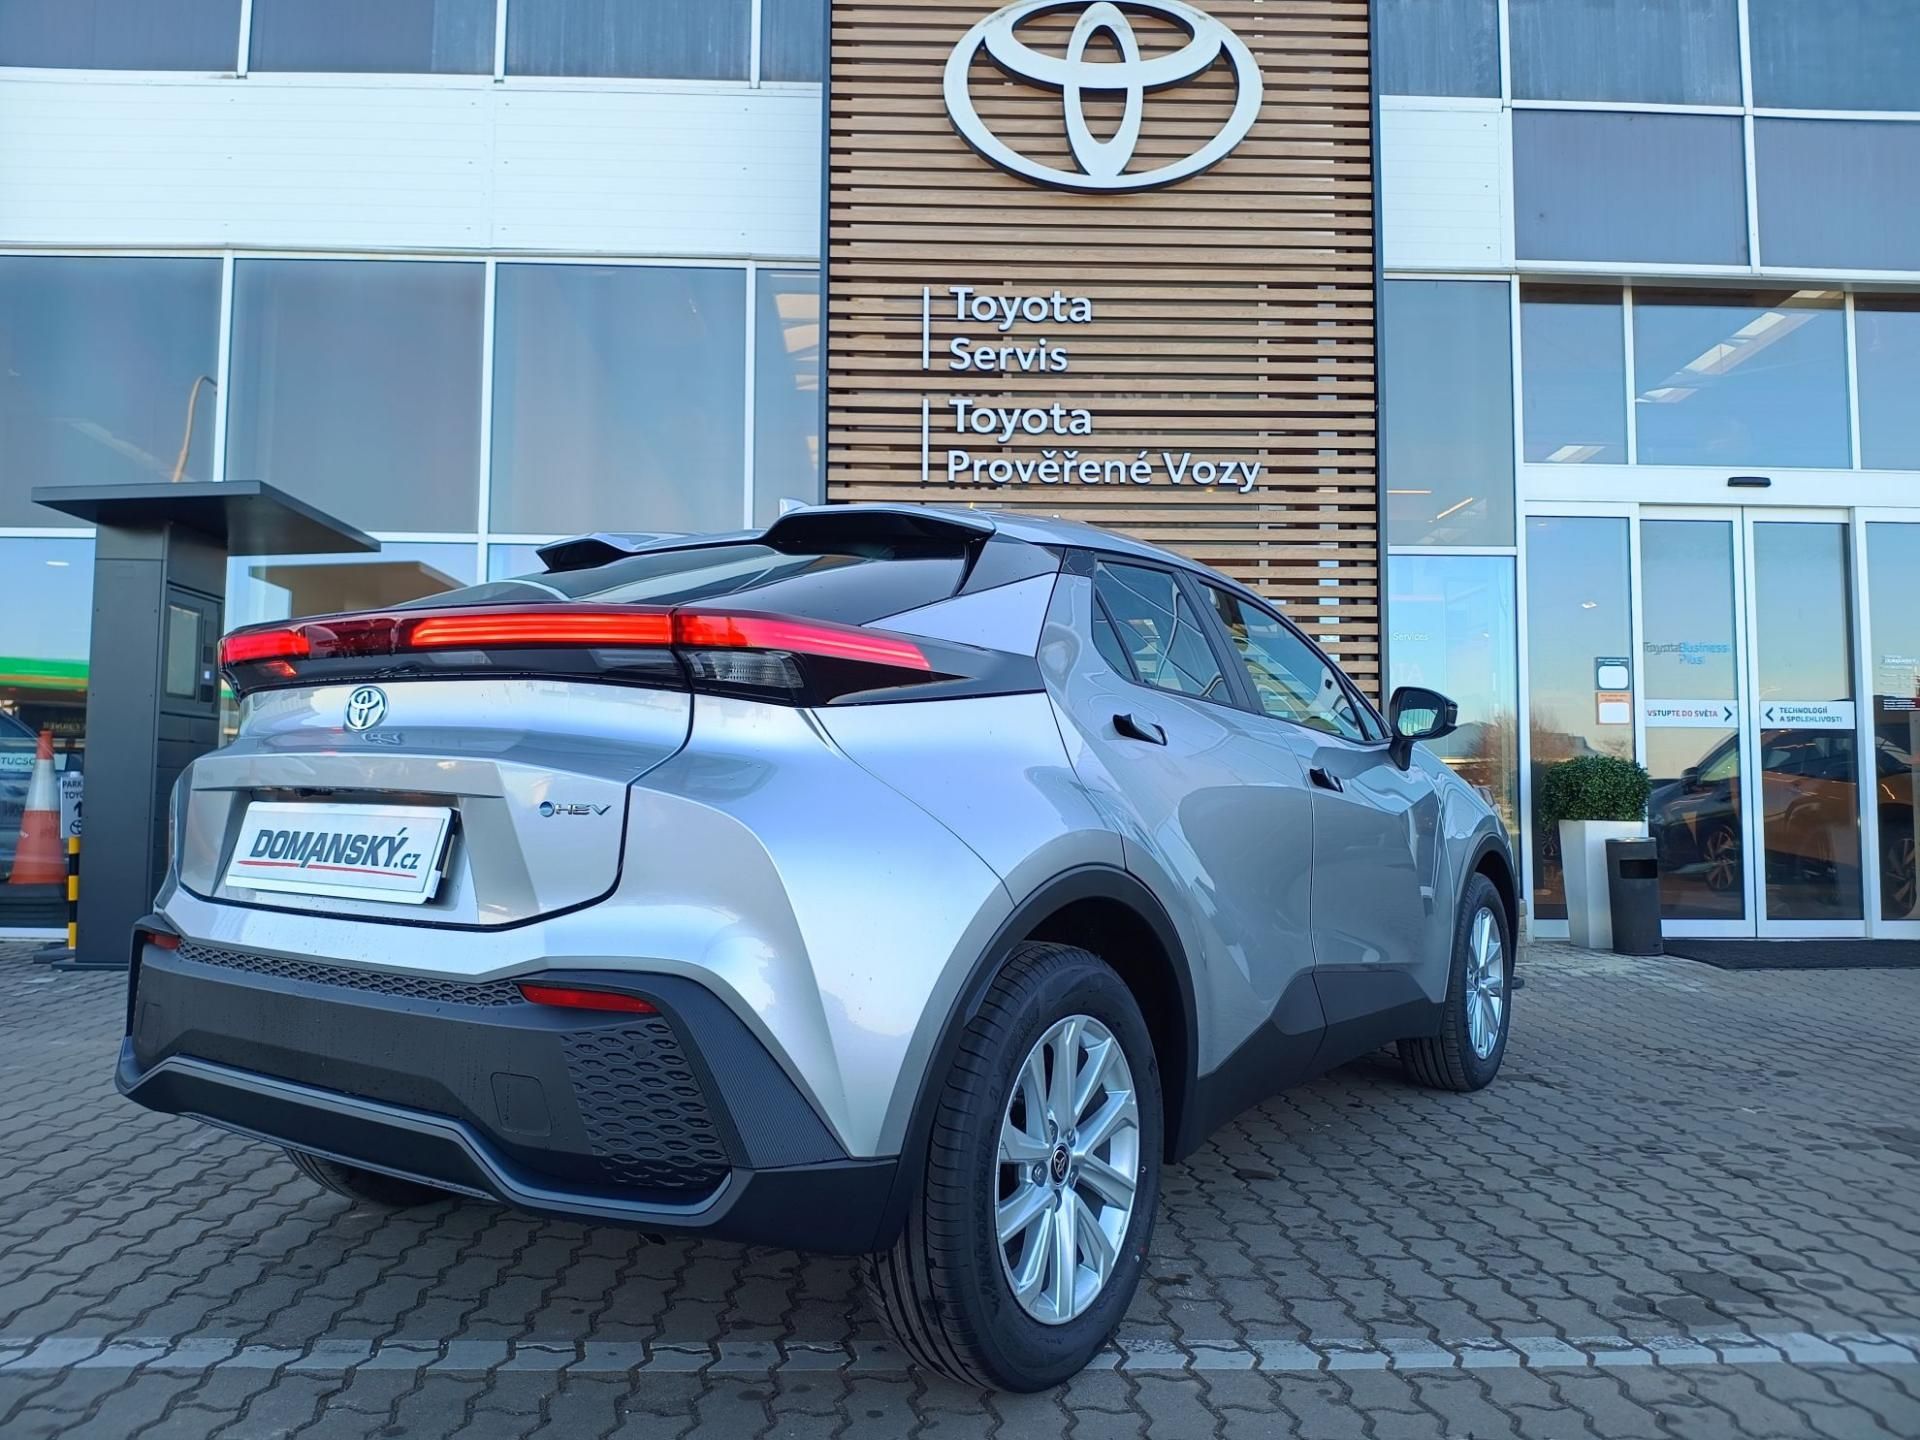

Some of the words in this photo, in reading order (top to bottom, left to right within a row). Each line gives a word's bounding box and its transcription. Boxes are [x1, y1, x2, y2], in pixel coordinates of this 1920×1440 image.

[948, 286, 1093, 331] Toyota
[948, 337, 1069, 372] Servis
[948, 399, 1093, 443] Toyota
[946, 449, 1153, 486] Prověřené
[1162, 452, 1262, 493] Vozy
[1647, 709, 1680, 717] VSTUPTE
[1681, 709, 1693, 717] DO
[1694, 708, 1719, 717] SVĚTA
[1786, 715, 1842, 723] SPOLEHLIVOSTI
[555, 803, 612, 816] HEV
